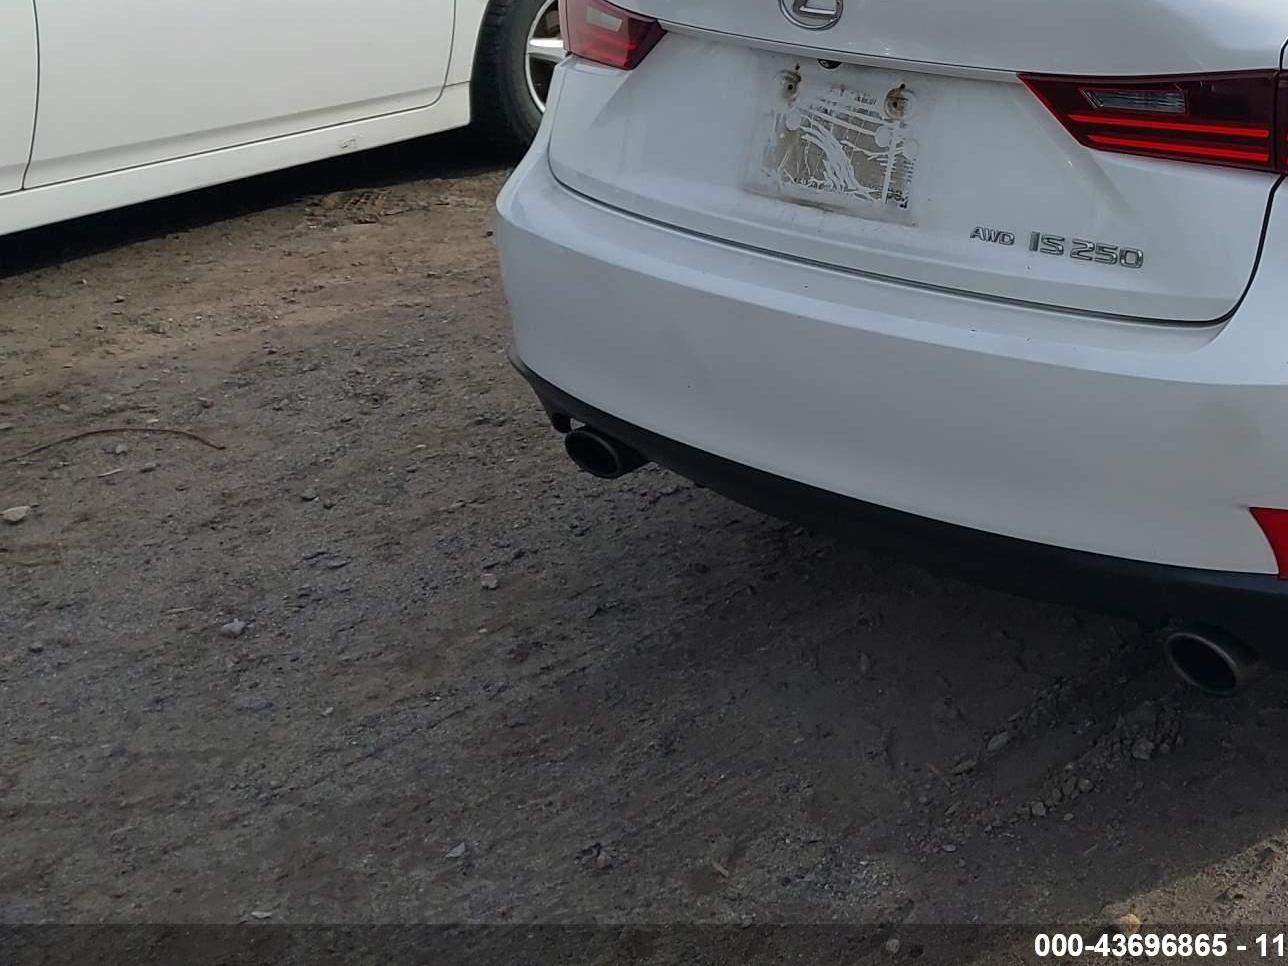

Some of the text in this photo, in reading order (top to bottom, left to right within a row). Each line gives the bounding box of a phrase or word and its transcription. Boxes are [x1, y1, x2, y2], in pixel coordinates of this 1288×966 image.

[970, 226, 1016, 246] AWD
[1029, 231, 1144, 269] IS 250
